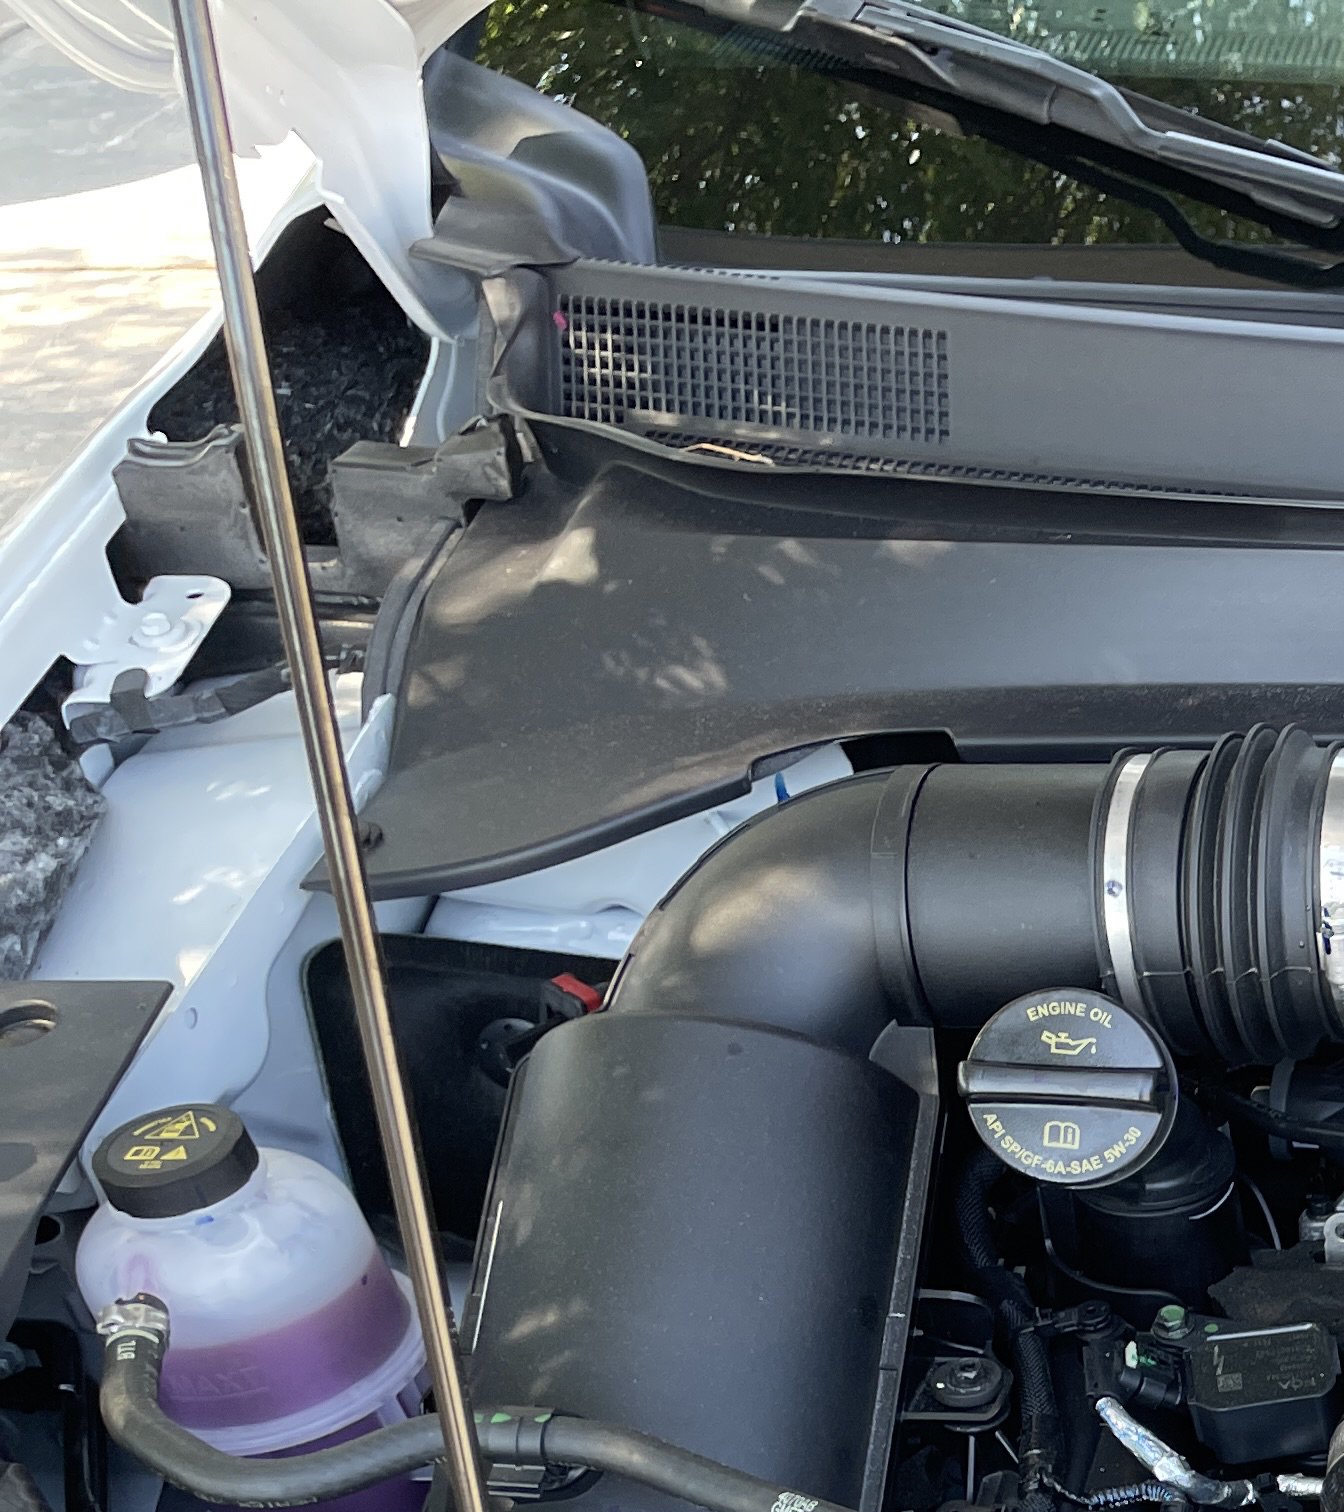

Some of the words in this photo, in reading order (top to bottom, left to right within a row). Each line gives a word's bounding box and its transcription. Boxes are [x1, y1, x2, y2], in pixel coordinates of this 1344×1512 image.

[1026, 1001, 1087, 1022] ENGINE
[1089, 1007, 1113, 1028] OIL
[983, 1113, 1006, 1139] API
[1104, 1126, 1142, 1163] 5W-30
